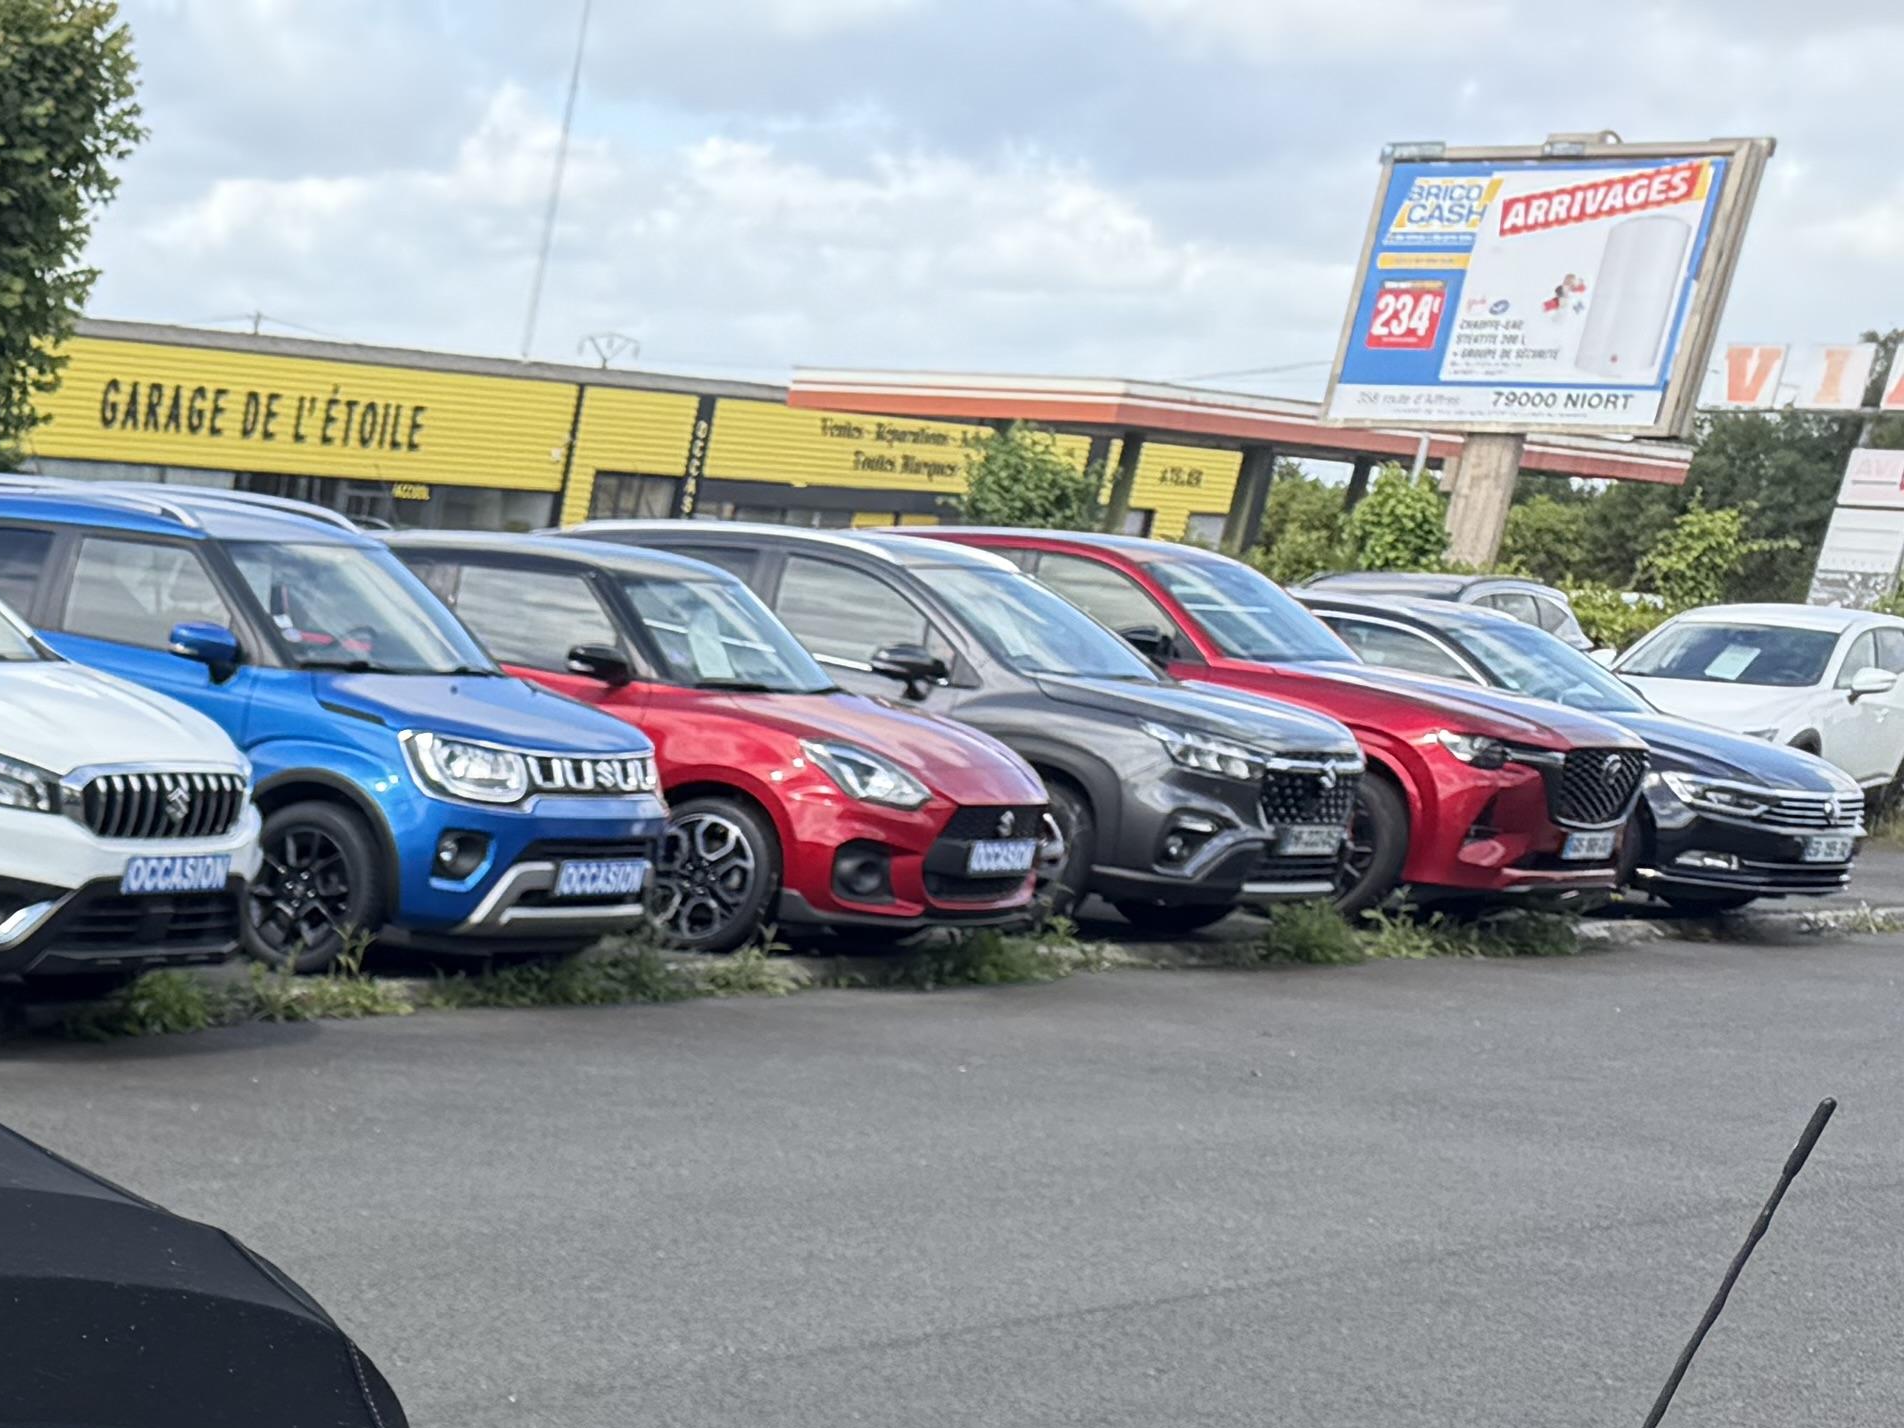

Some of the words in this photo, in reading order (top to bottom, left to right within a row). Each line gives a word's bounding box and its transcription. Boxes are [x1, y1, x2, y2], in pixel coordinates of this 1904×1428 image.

[1408, 184, 1483, 202] BRICO
[1503, 170, 1692, 229] ARRIVAGES
[1406, 202, 1486, 225] CASH
[100, 378, 229, 437] GARAGE
[242, 391, 283, 441] DE
[293, 382, 427, 452] L'ÉTOILE
[1491, 391, 1558, 408] 79000
[1563, 392, 1635, 411] NIORT
[128, 857, 230, 891] OCCASION
